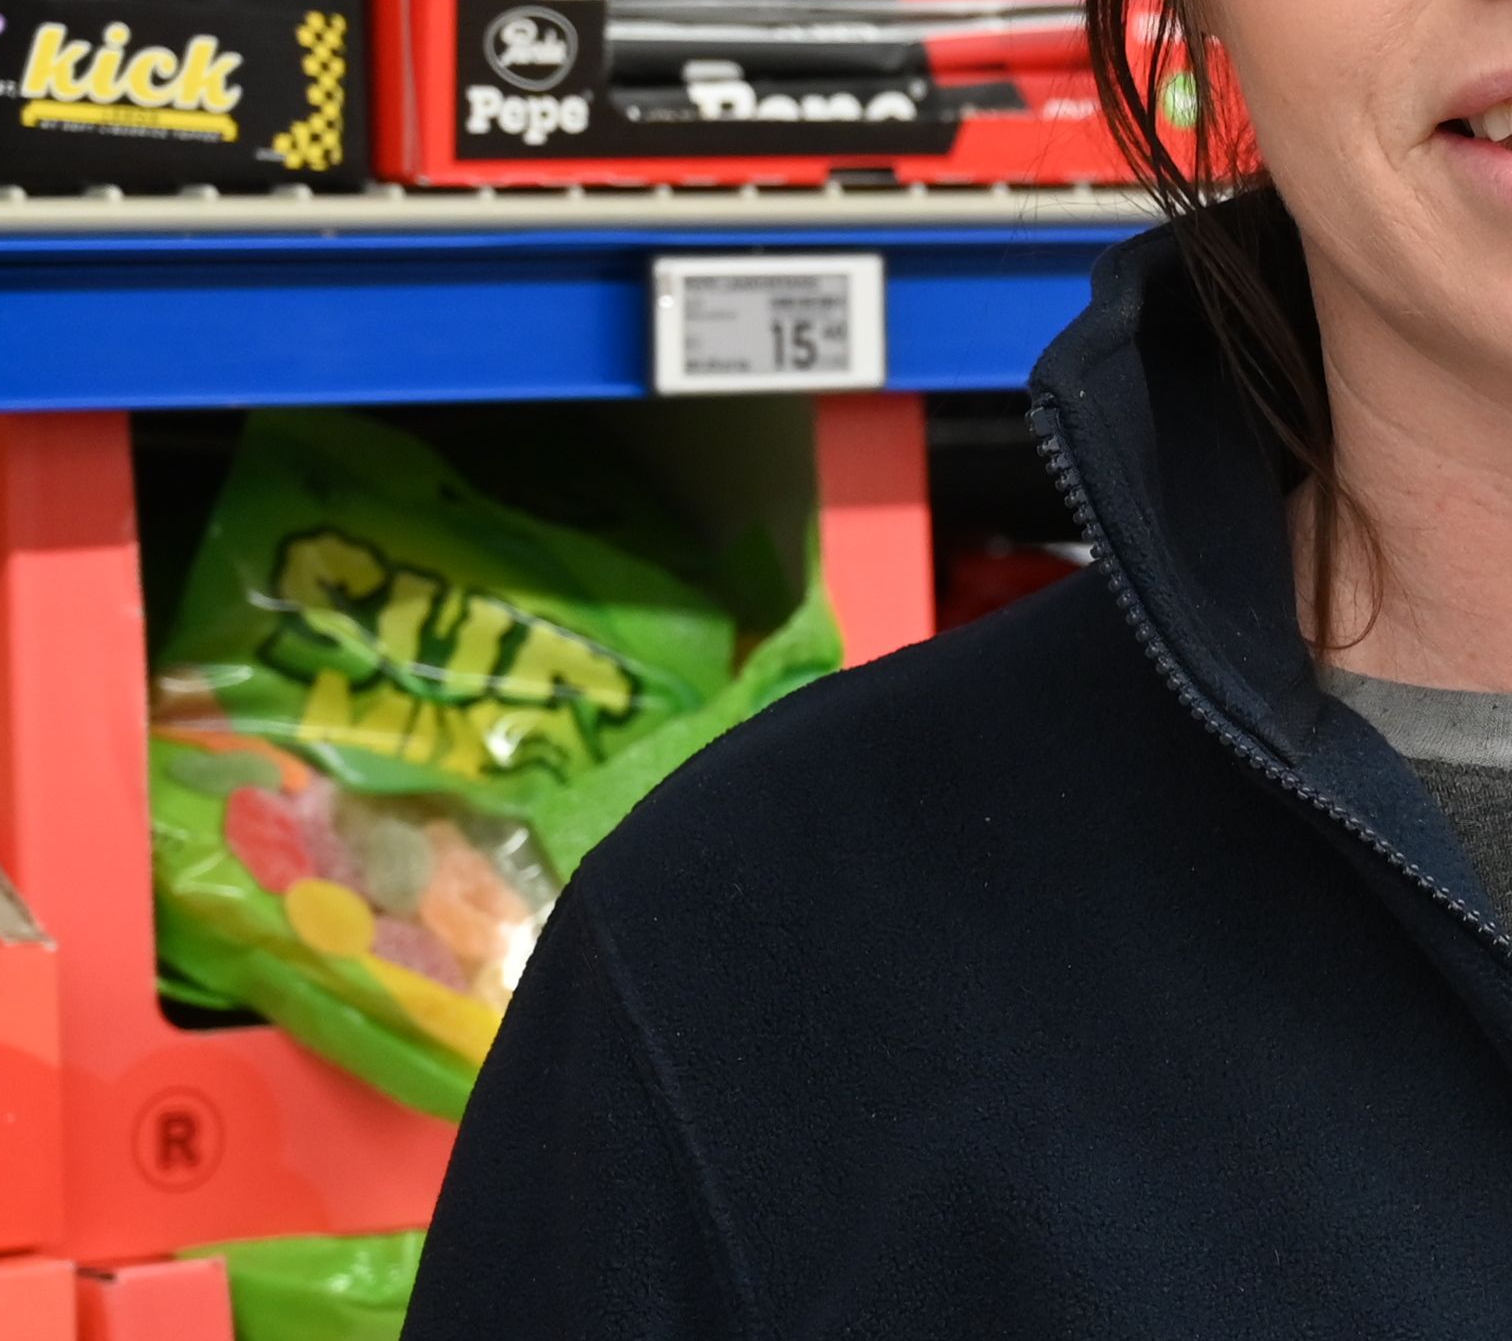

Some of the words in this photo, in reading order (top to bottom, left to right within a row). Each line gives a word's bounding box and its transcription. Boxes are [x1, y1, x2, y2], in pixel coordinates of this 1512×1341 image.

[20, 21, 243, 114] kick
[466, 85, 588, 145] Pepe
[772, 320, 817, 371] 15
